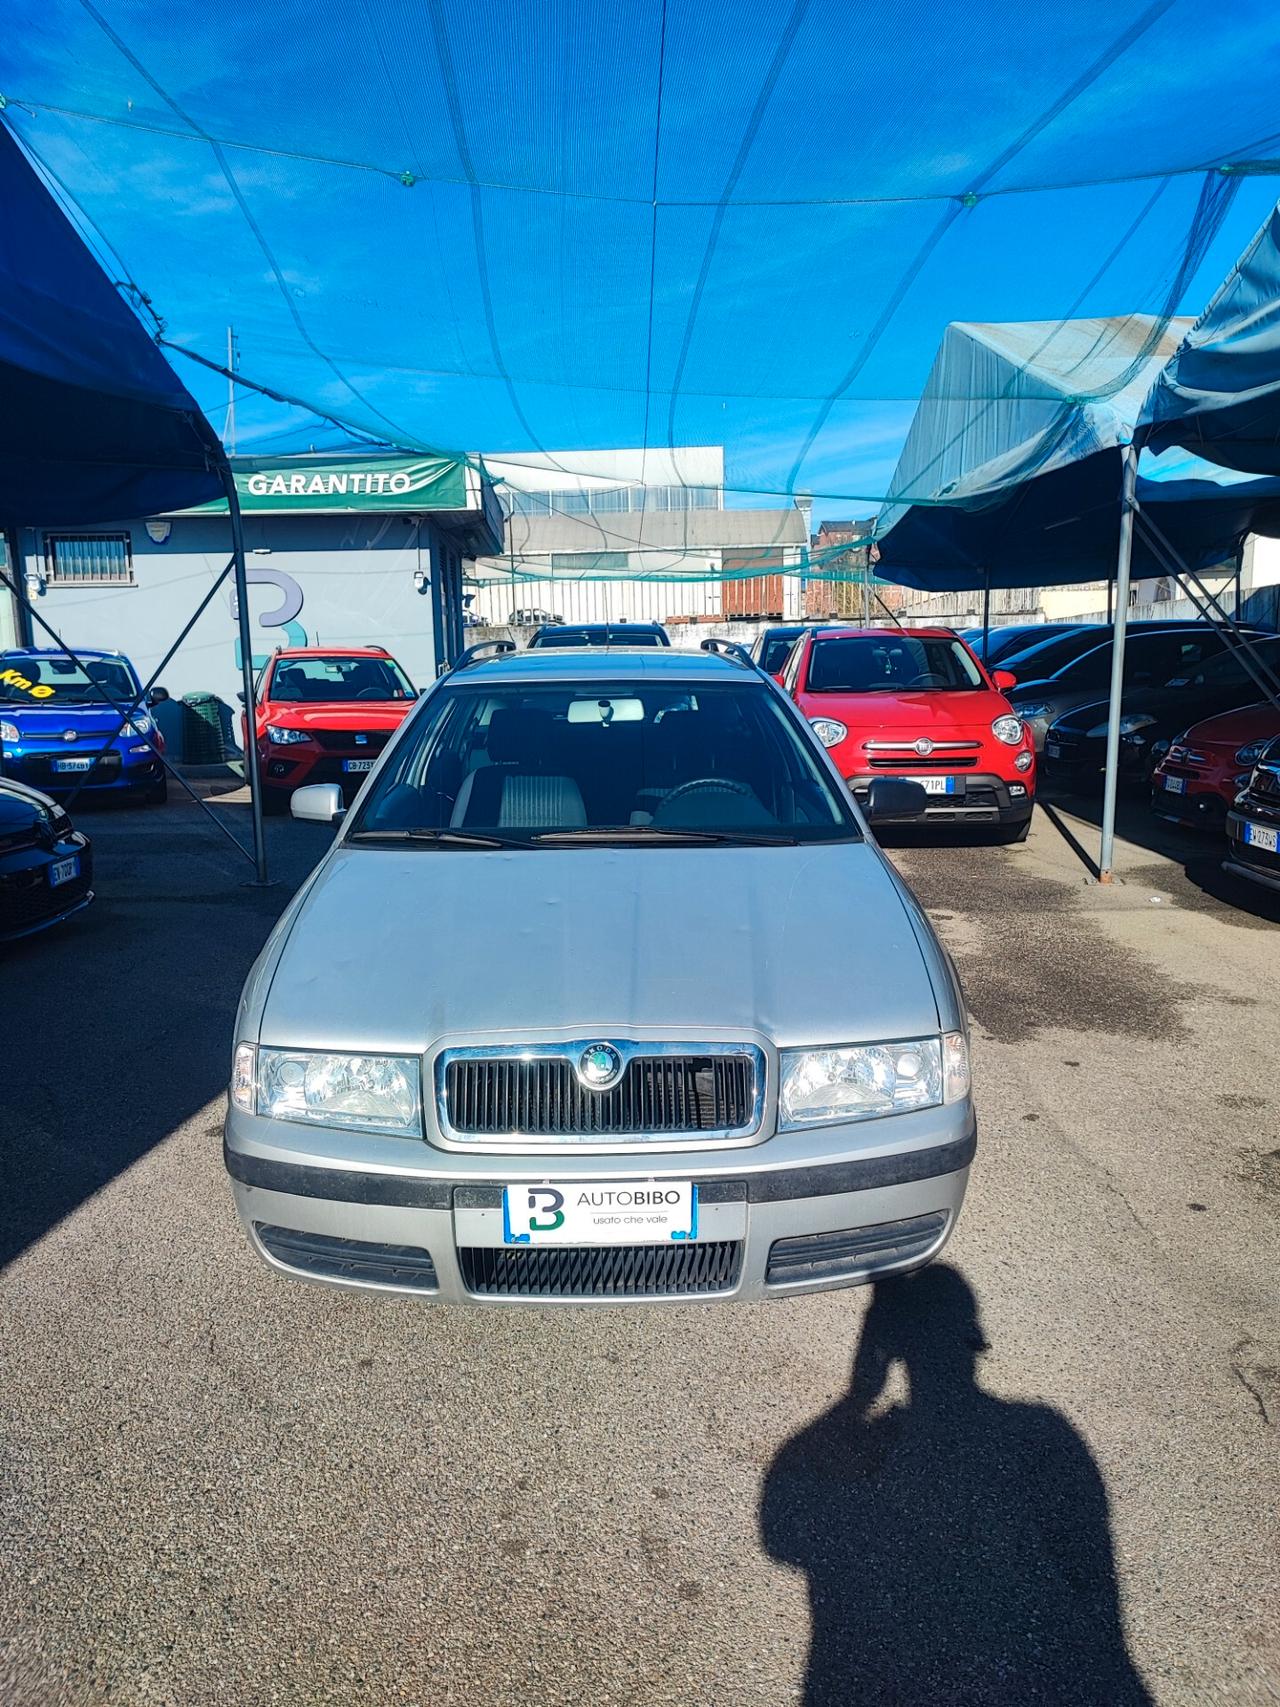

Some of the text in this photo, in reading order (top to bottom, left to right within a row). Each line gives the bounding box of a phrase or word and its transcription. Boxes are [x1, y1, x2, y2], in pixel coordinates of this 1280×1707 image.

[248, 473, 411, 496] GARANTITO
[577, 1190, 681, 1207] AUTOBIBO
[593, 1215, 668, 1225] usato che vale
